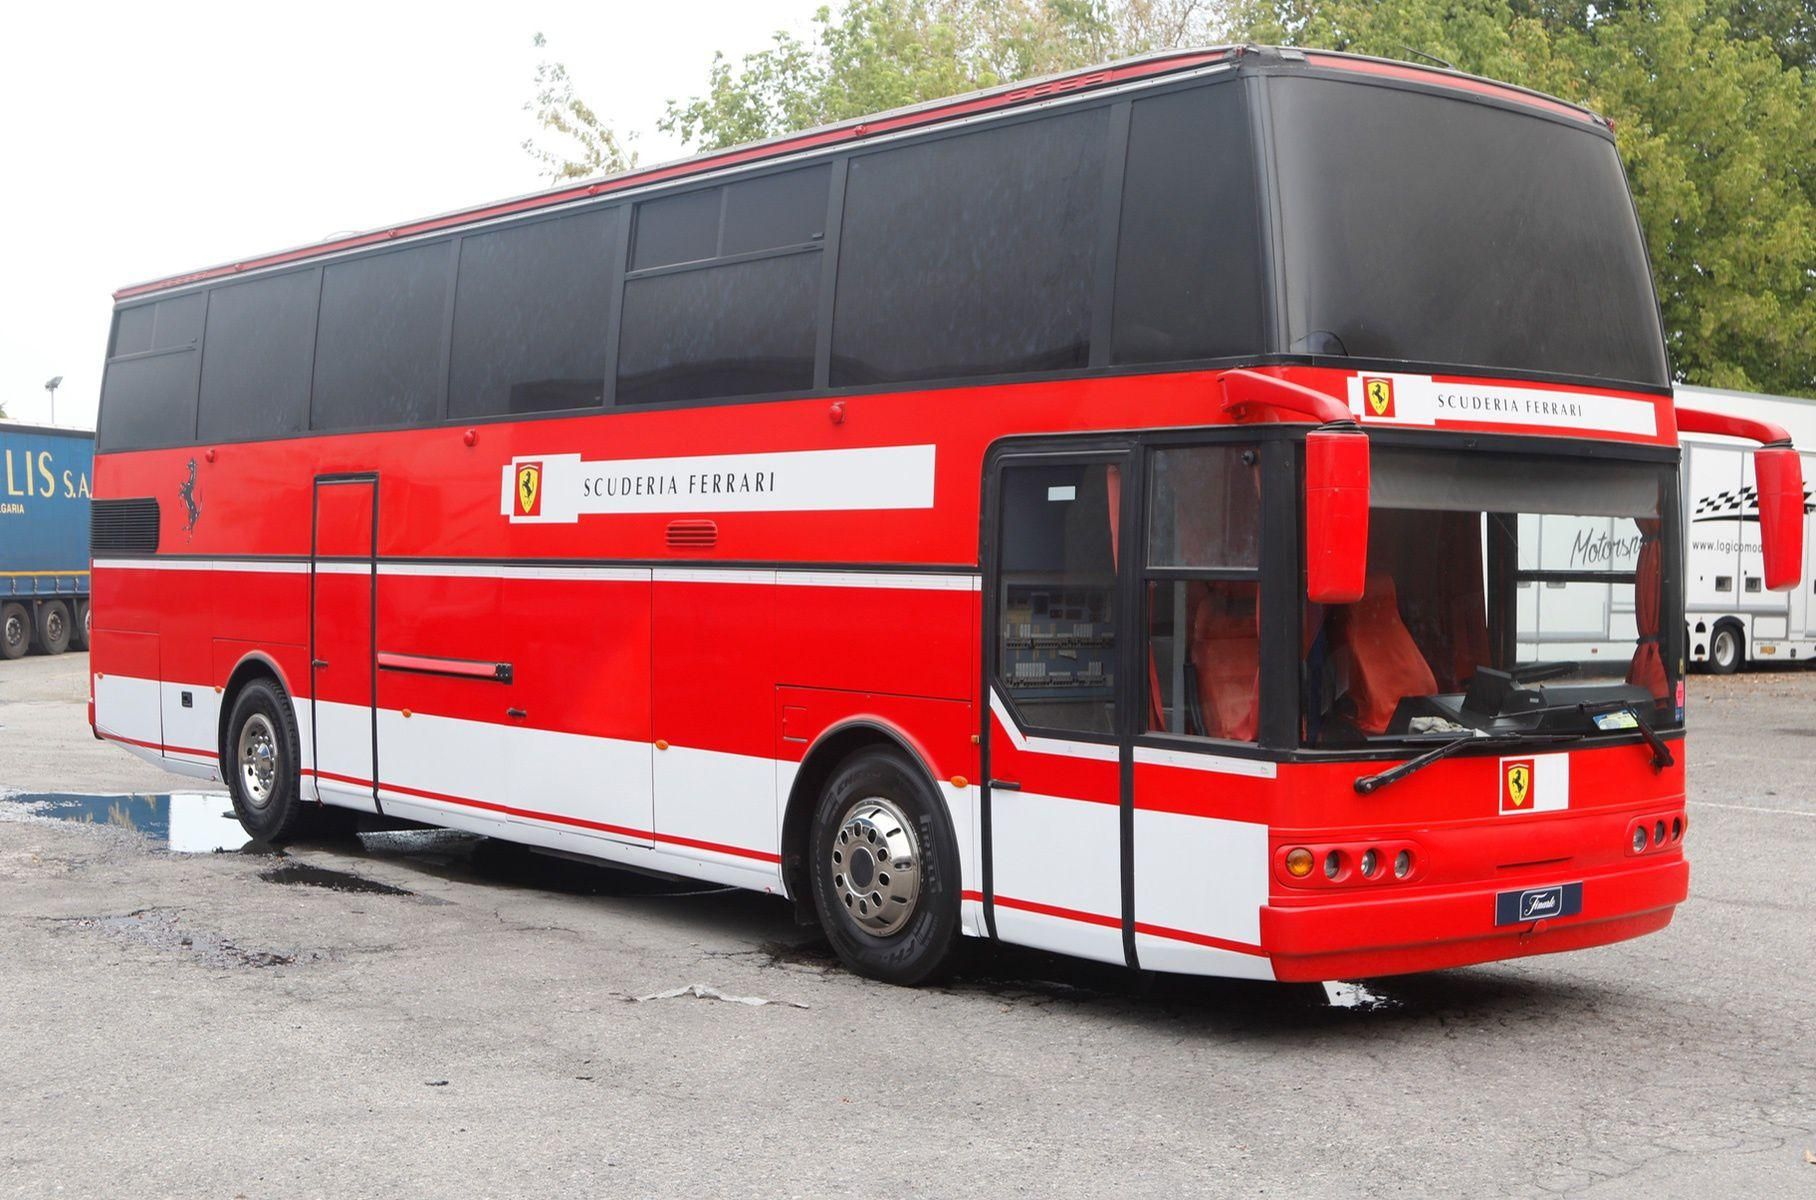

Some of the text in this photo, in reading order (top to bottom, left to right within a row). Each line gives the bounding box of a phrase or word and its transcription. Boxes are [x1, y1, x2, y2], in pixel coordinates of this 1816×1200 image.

[1437, 394, 1582, 417] SCUDERIA FERRARI
[583, 471, 775, 497] SCUDERIA FERRARI
[0, 502, 25, 514] GARIA
[1569, 527, 1641, 569] Motorsp
